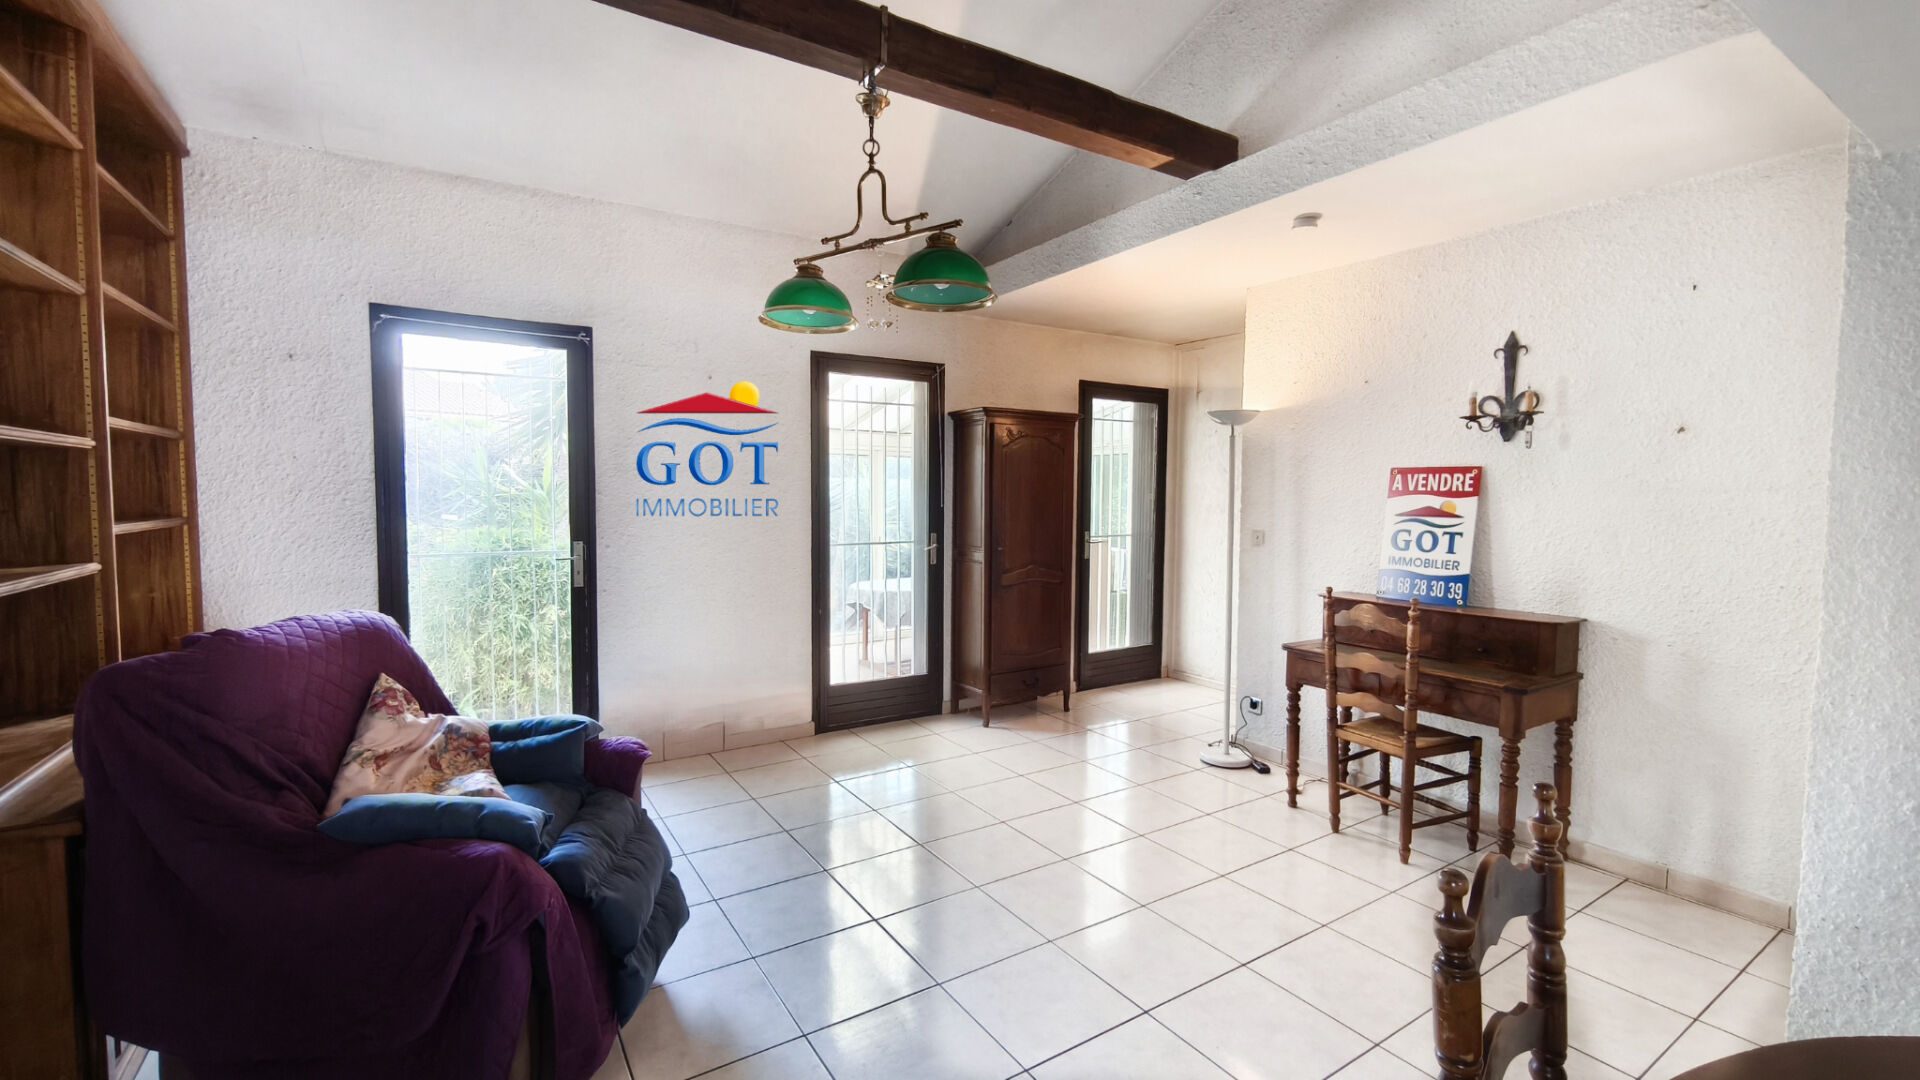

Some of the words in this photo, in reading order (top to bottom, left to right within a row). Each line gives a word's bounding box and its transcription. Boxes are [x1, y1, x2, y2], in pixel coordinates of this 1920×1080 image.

[1407, 473, 1473, 491] VENDRE
[1391, 529, 1463, 554] GOT
[1388, 556, 1460, 571] IMMOBILIER
[1397, 577, 1411, 594] 68
[1414, 579, 1428, 596] 28
[1430, 581, 1445, 598] 30
[1448, 582, 1463, 600] 39
